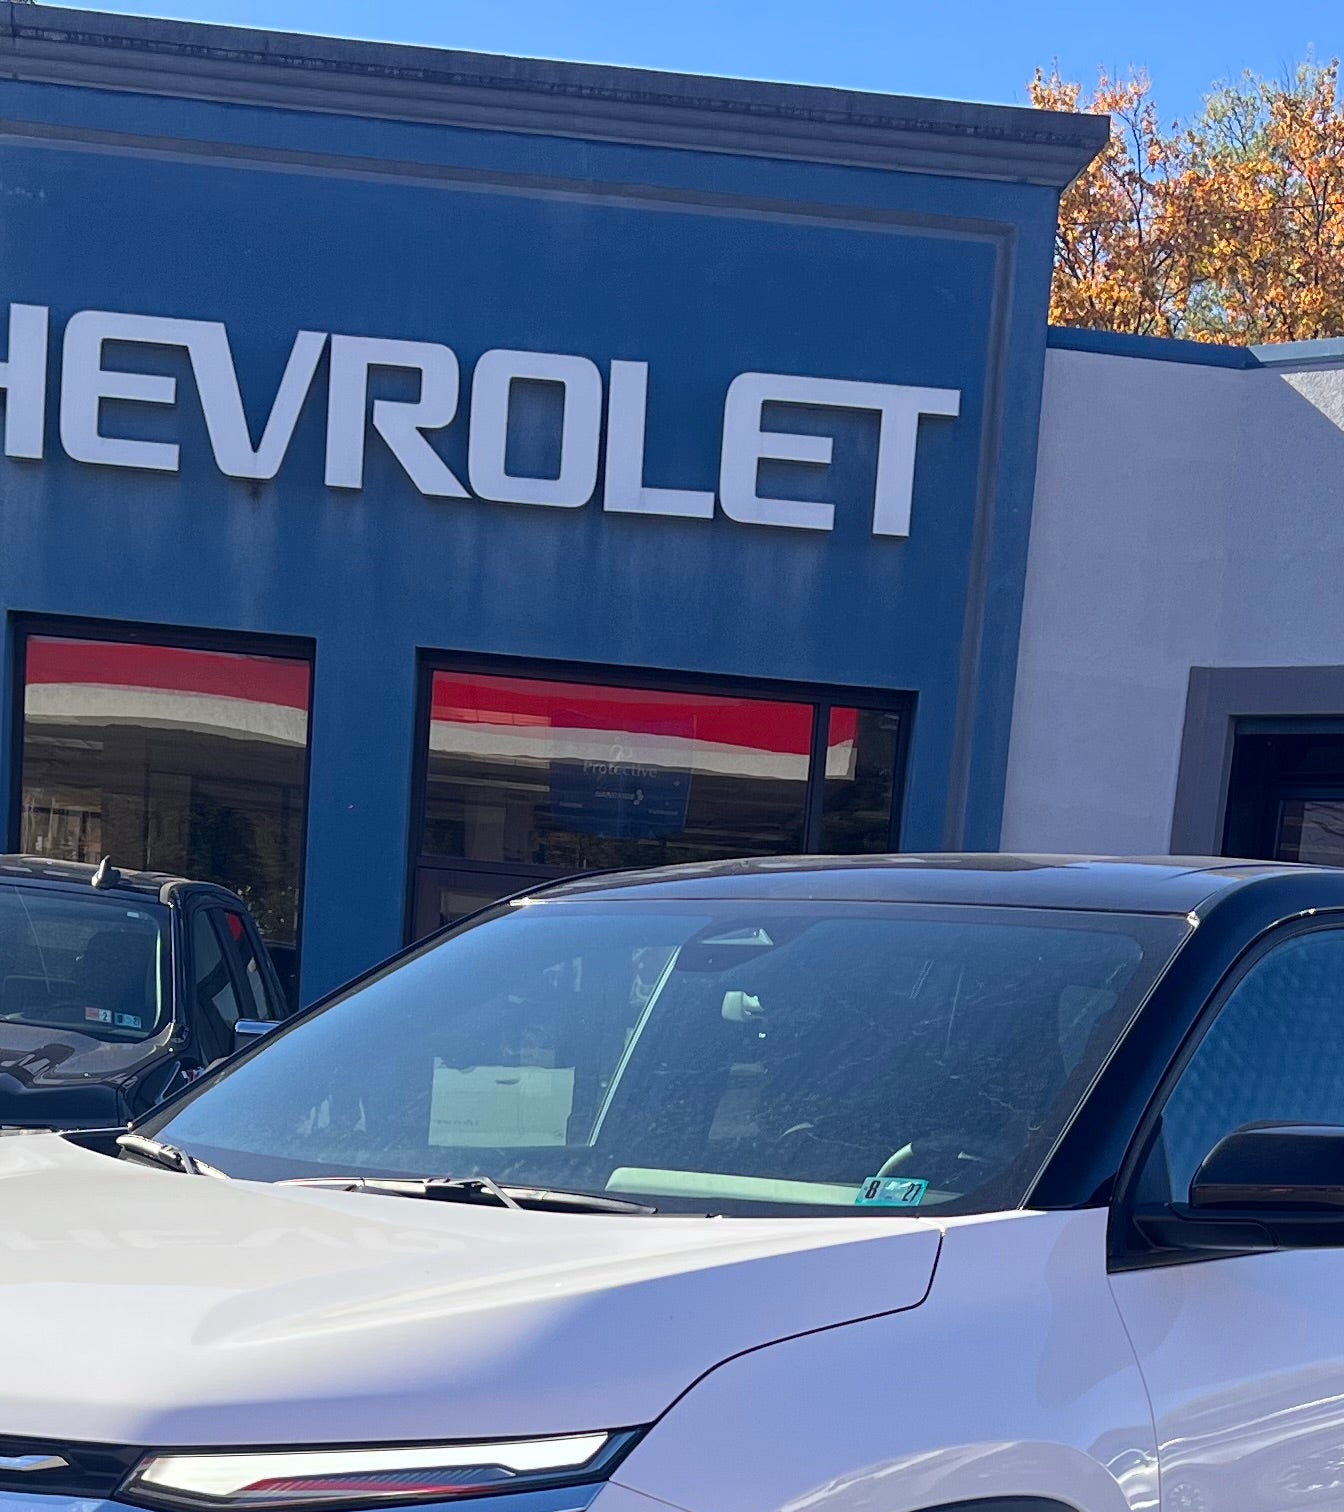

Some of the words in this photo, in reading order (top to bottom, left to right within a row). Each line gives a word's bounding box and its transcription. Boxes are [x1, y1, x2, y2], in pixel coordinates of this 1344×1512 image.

[583, 760, 658, 778] Protective
[865, 1180, 881, 1199] 8
[901, 1183, 923, 1202] 27
